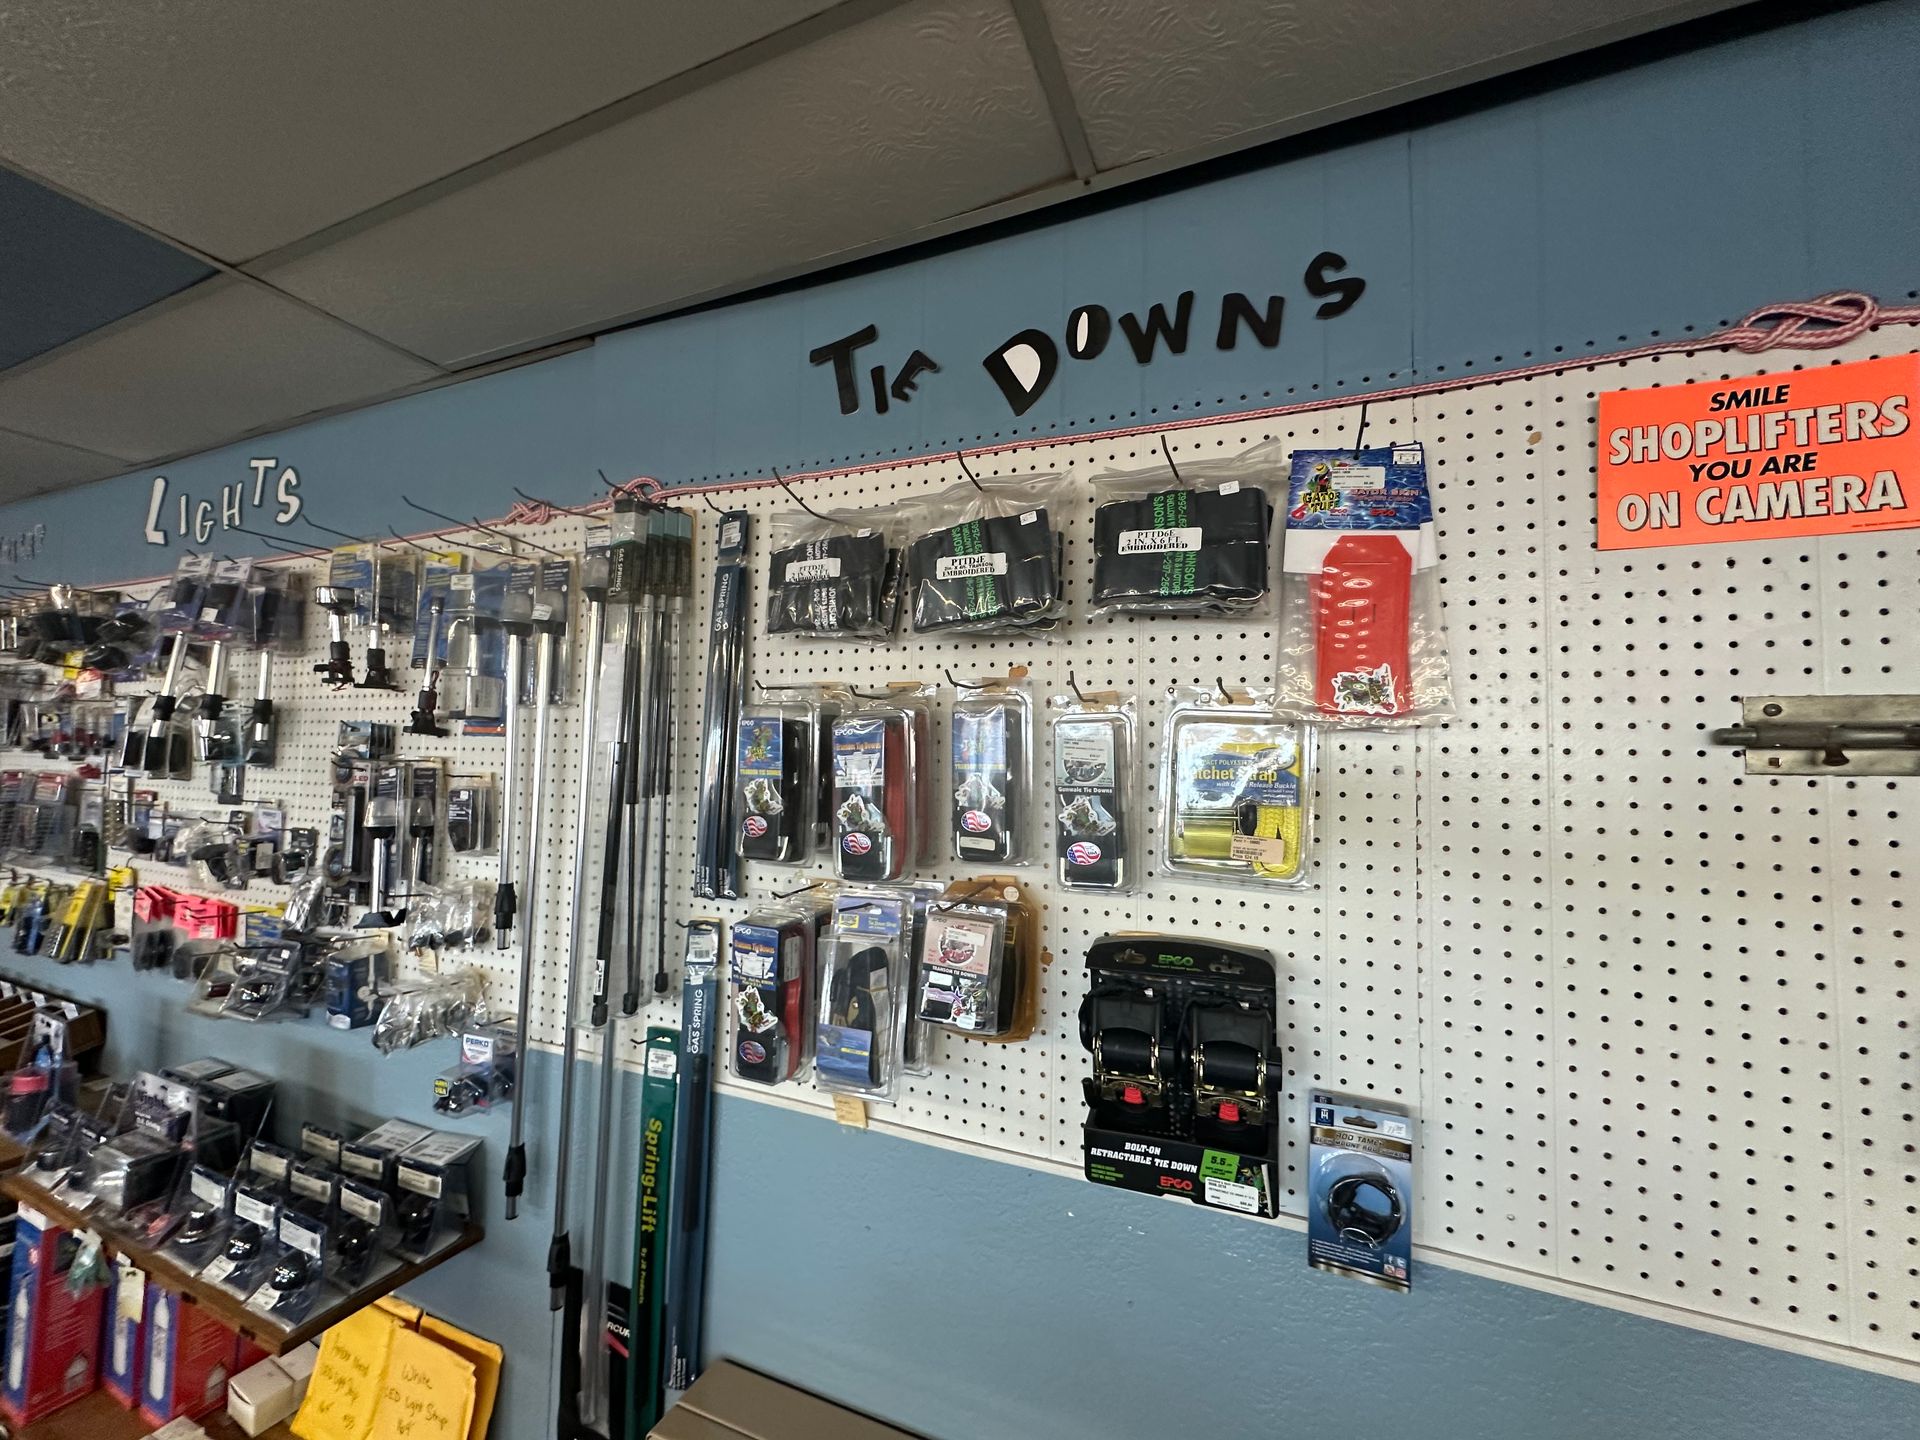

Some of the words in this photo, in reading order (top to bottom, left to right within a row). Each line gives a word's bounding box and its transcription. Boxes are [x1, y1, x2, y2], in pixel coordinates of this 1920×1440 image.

[1709, 384, 1790, 412] SMILE
[1608, 395, 1910, 465] SHOPLIFTERS
[1688, 458, 1752, 482] YOU
[1759, 452, 1818, 475] ARE
[1616, 490, 1680, 532] ON
[1695, 469, 1907, 526] CAMERA
[1121, 542, 1188, 552] EMBROIDERED
[1151, 537, 1158, 545] X
[943, 567, 996, 578] EMBROIDERED
[717, 573, 729, 608] SPRING
[714, 611, 724, 632] GAS
[692, 988, 704, 1029] SPRING
[465, 1037, 489, 1048] PERKO
[691, 1031, 701, 1054] GAS
[1090, 1147, 1153, 1165] RETRACTABLE
[1153, 1158, 1169, 1170] TIE
[1170, 1161, 1198, 1175] DOWN
[1124, 1142, 1162, 1156] BOLT-ON
[1210, 1156, 1227, 1166] 5.5
[641, 1117, 663, 1233] Spring-Lift
